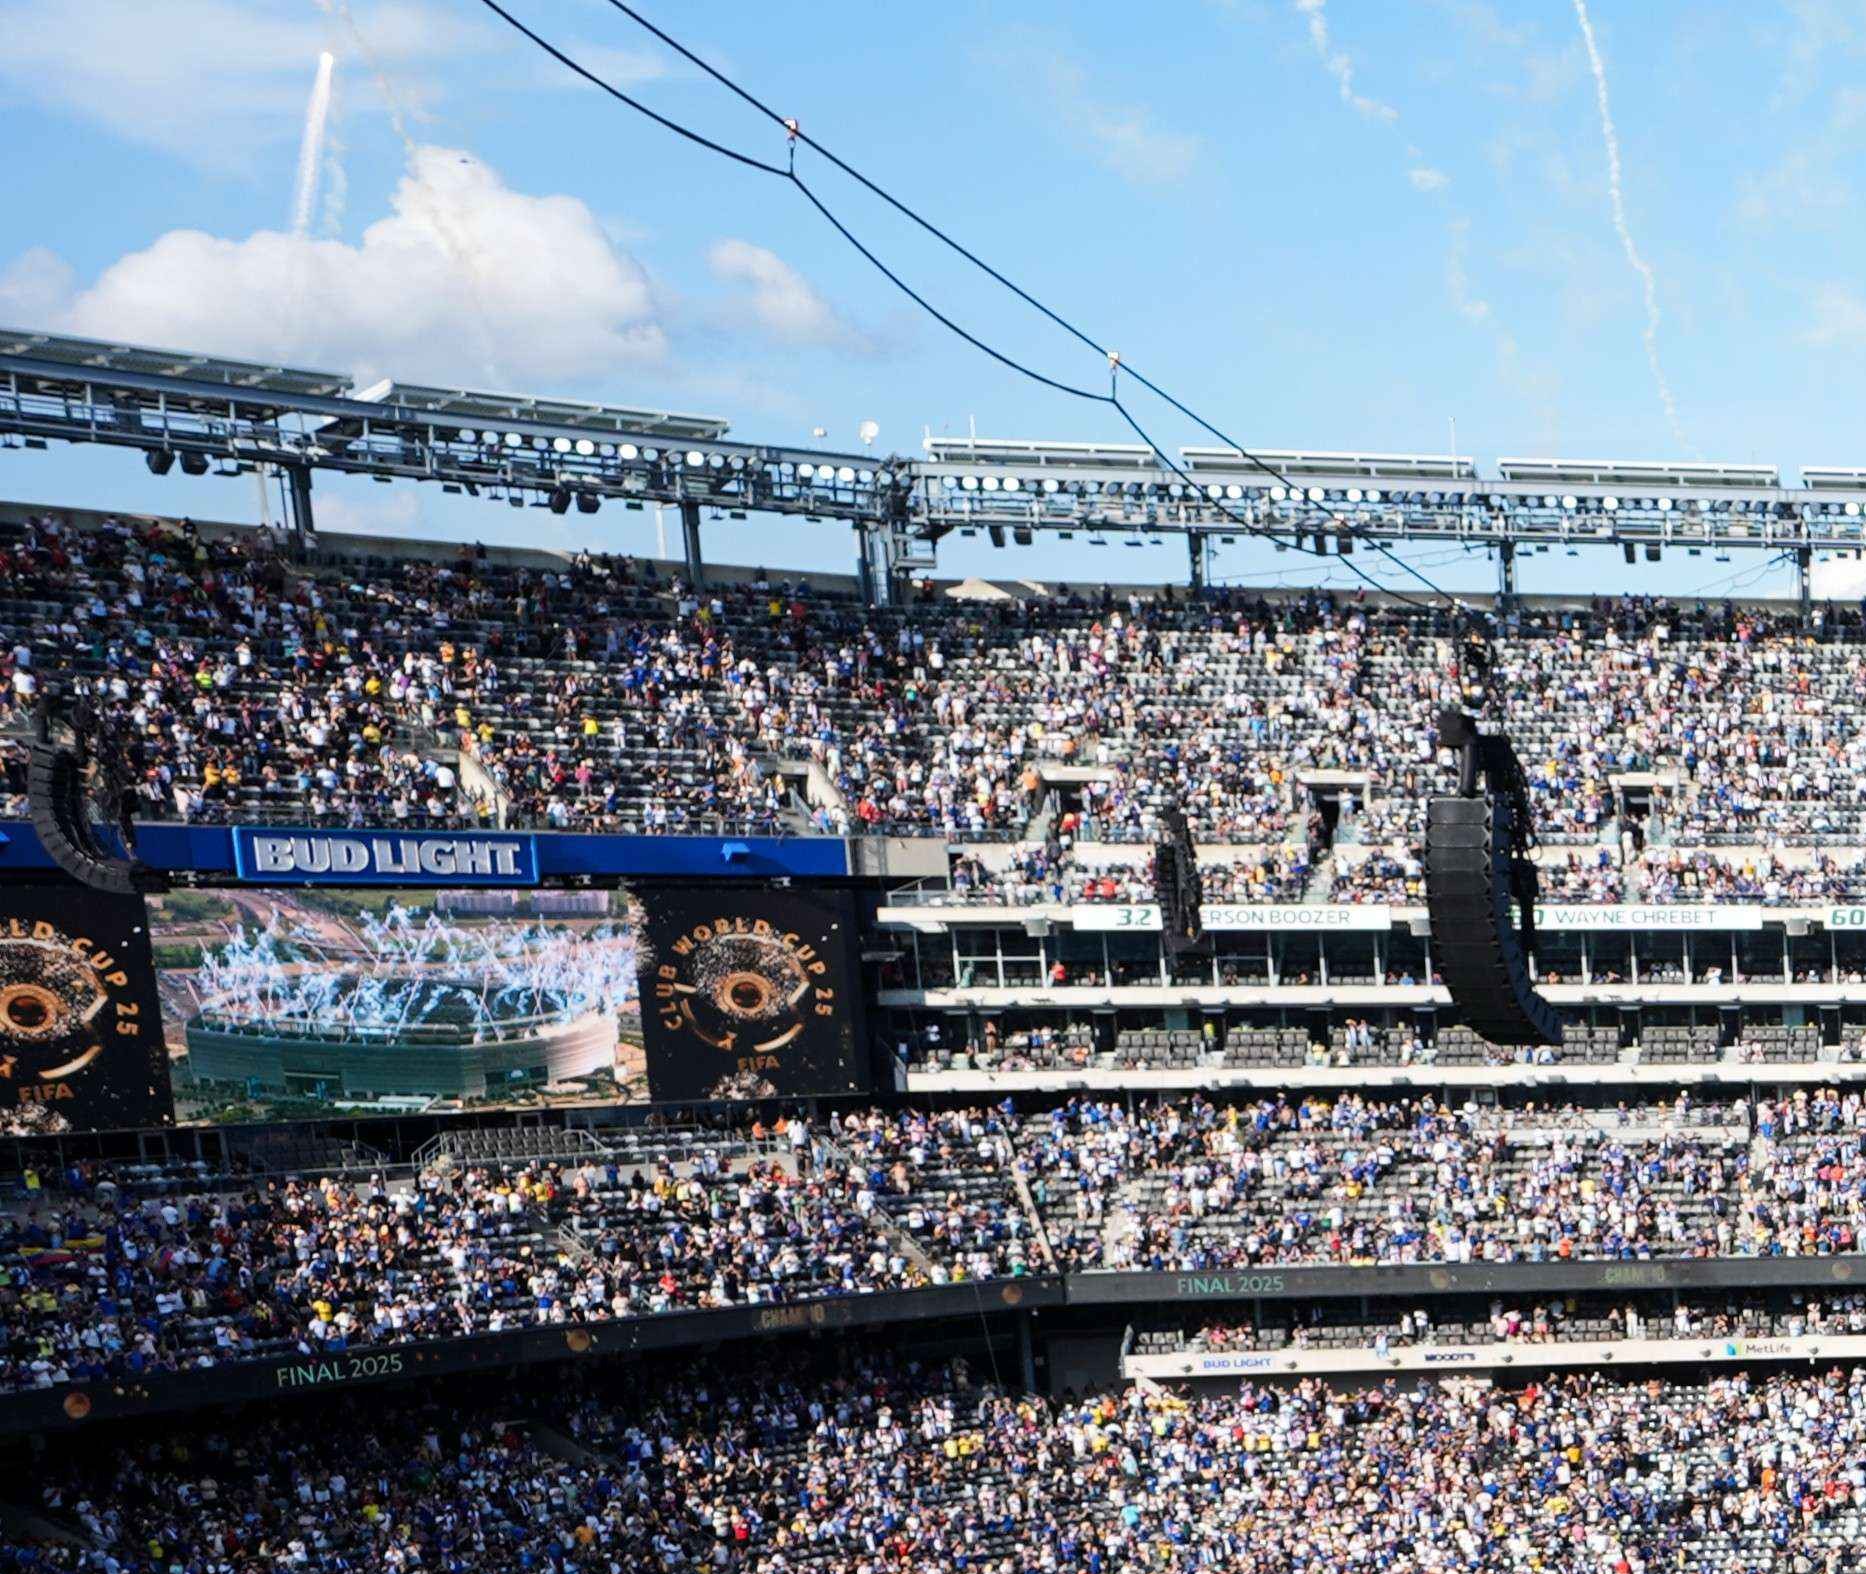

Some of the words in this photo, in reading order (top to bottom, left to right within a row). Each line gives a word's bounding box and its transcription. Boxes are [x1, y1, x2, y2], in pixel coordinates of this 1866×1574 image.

[253, 836, 370, 872] BUD
[373, 838, 521, 875] LIGHT
[1201, 909, 1265, 924] ERSON
[1270, 909, 1350, 924] BOOZER
[1554, 910, 1627, 924] WAYNE
[1631, 910, 1718, 924] CHREBET
[1831, 909, 1865, 926] 60
[18, 1081, 75, 1102] FIFA
[1177, 1277, 1234, 1294] FINAL
[1238, 1275, 1284, 1293] 2025
[1745, 1343, 1792, 1354] MetLife
[277, 1361, 346, 1389] FINAL
[350, 1353, 403, 1378] 2025
[1203, 1359, 1231, 1369] BUD
